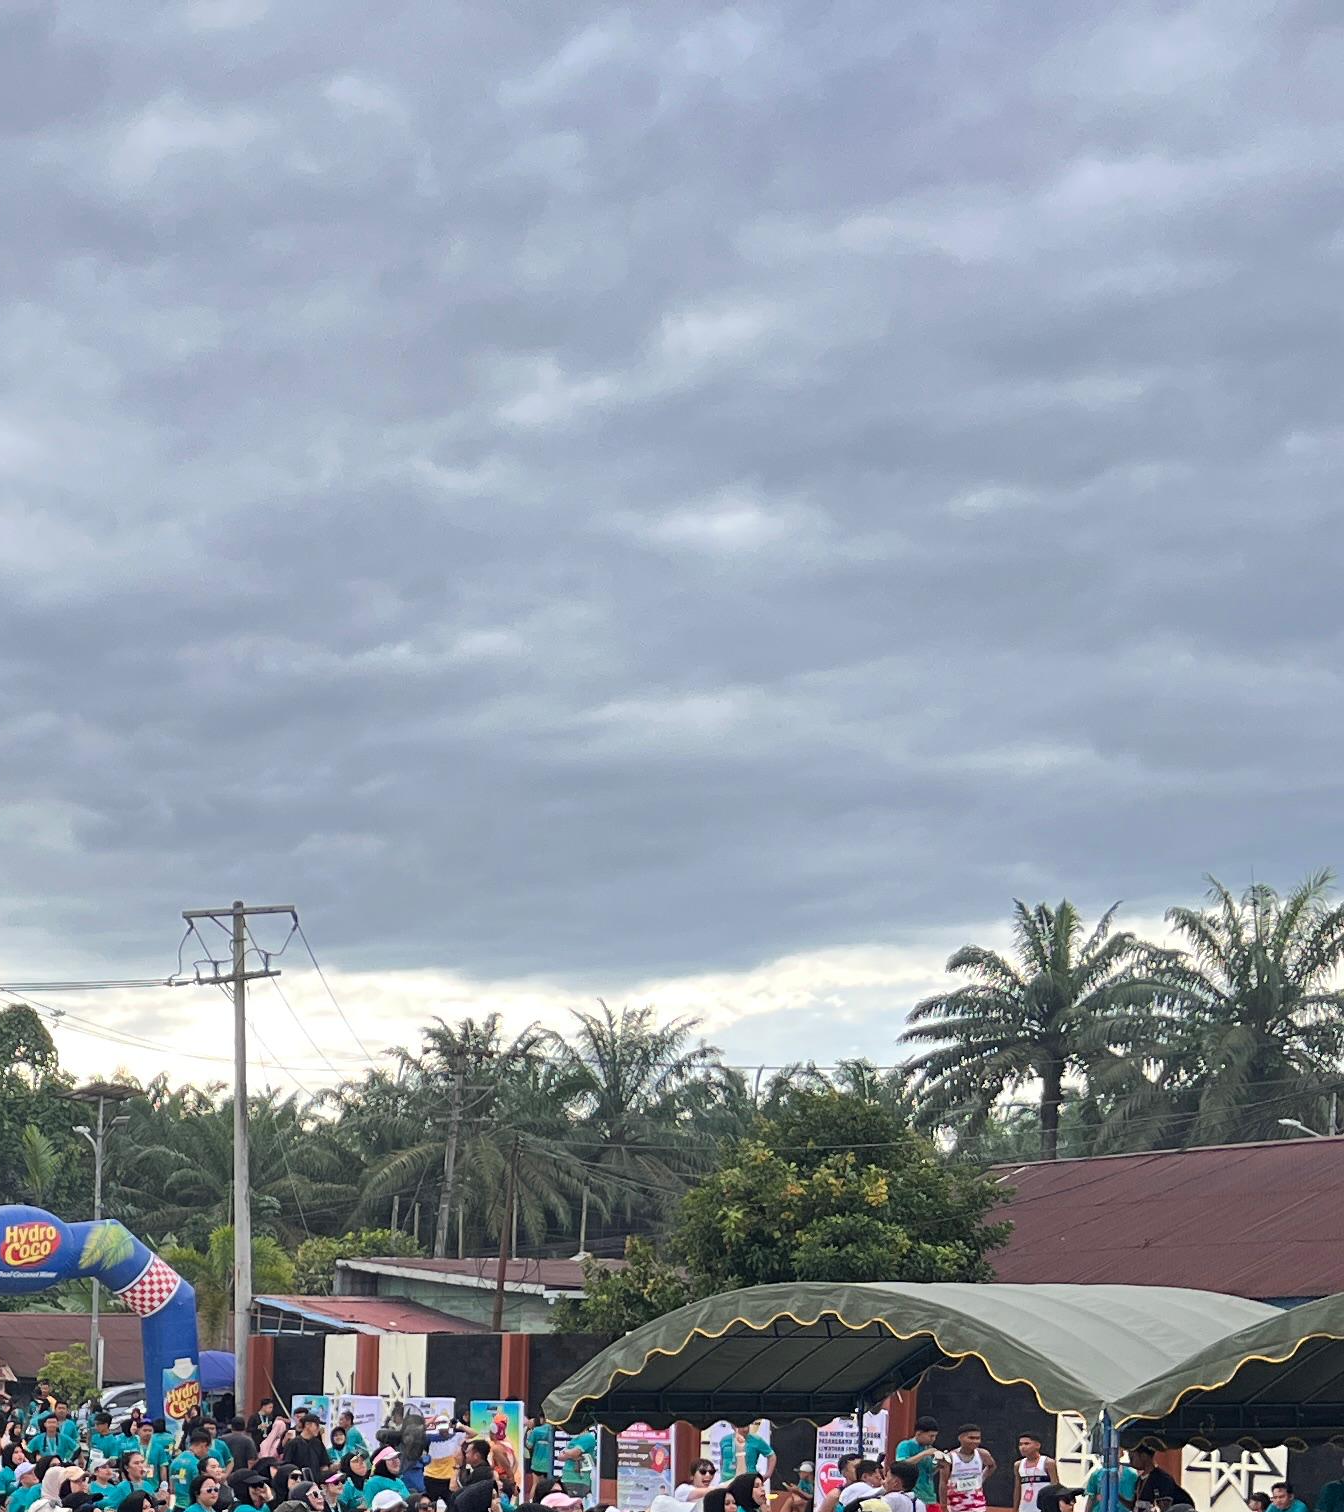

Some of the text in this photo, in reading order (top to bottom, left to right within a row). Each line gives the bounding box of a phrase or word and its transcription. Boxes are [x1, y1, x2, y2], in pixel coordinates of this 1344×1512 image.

[5, 1224, 57, 1244] Hydro
[4, 1241, 52, 1266] Coco
[166, 1381, 200, 1403] Hydro
